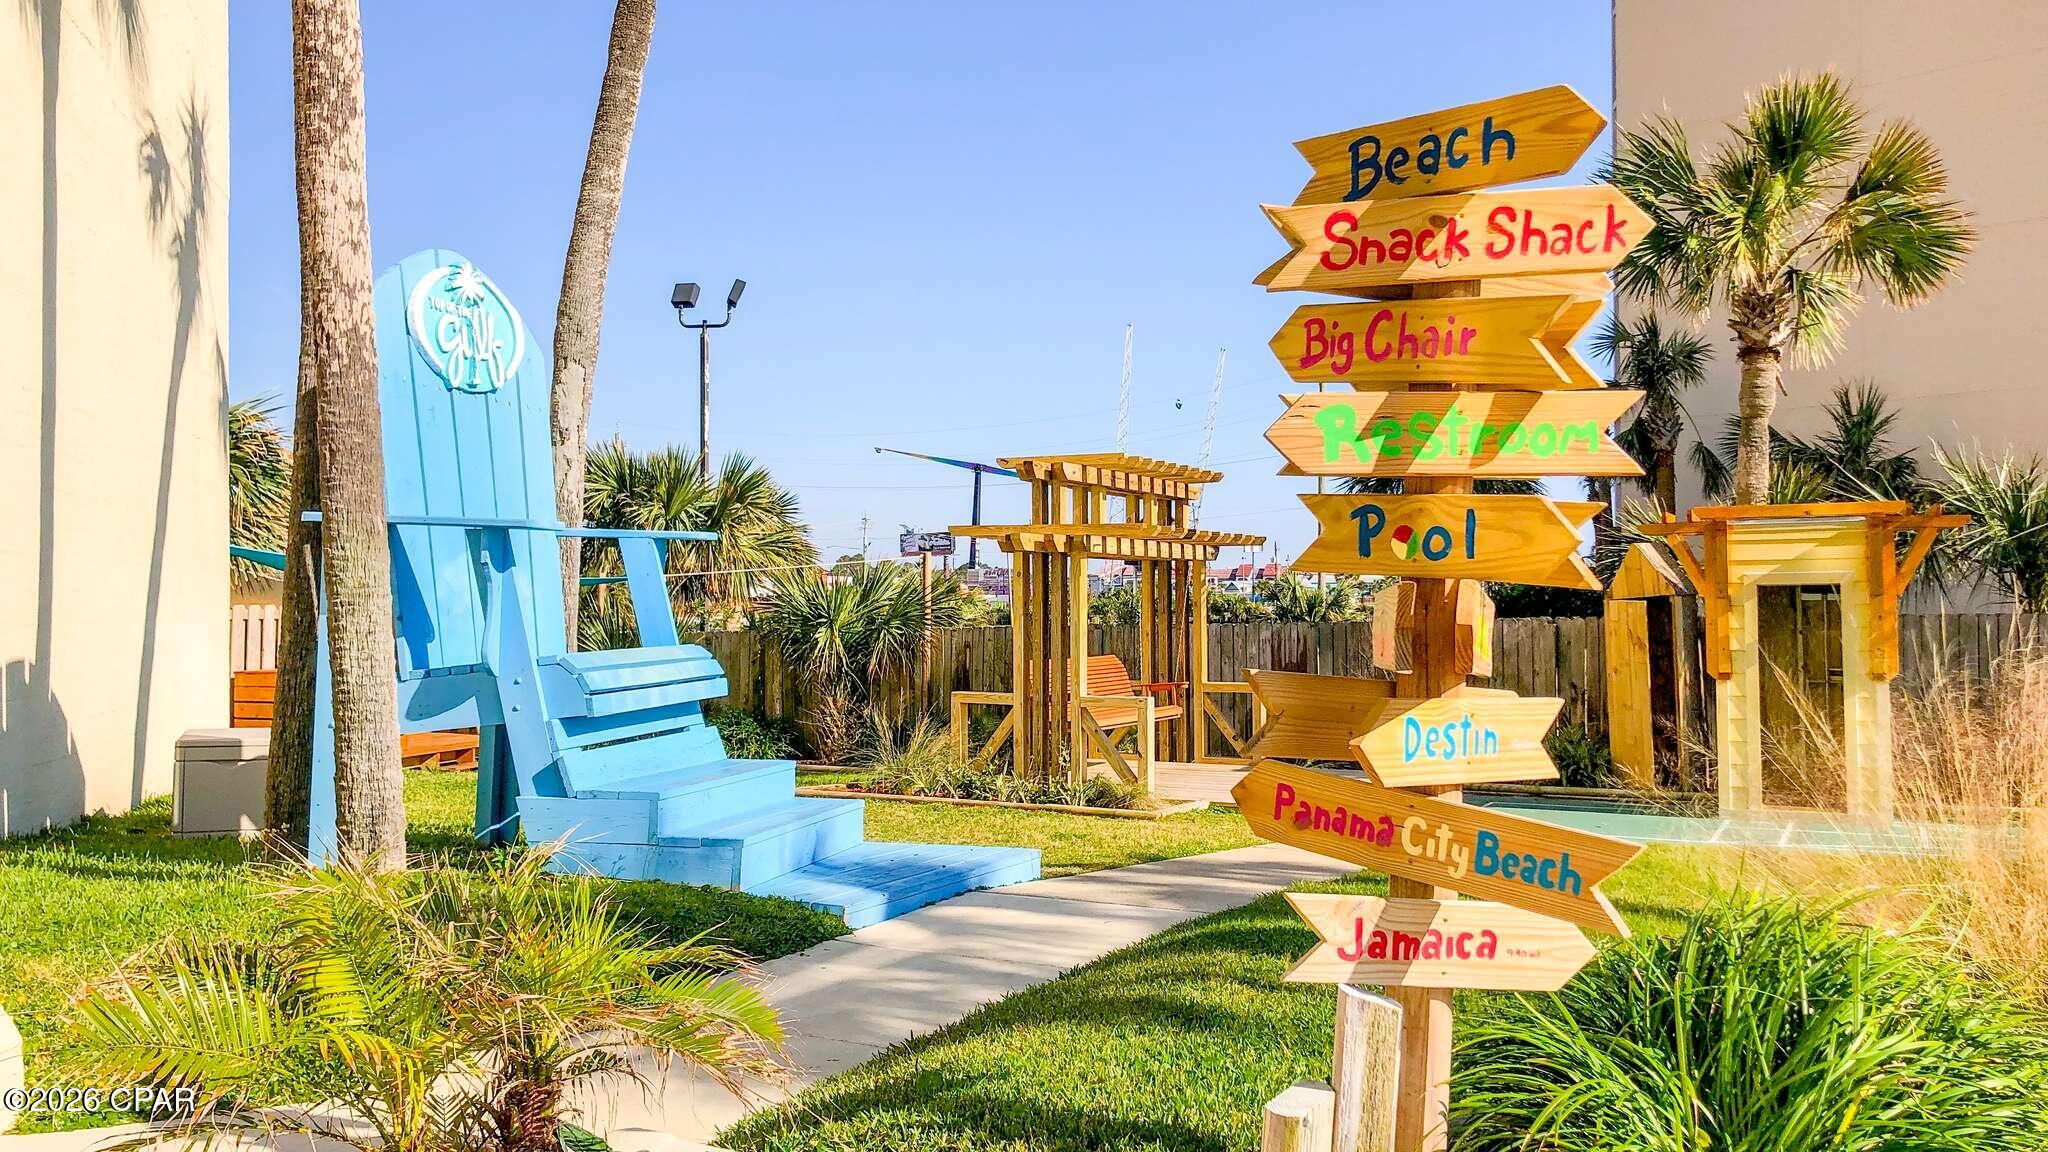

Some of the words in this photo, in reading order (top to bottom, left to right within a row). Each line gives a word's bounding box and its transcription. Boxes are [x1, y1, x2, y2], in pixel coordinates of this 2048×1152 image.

[1342, 116, 1516, 202] Beach
[1320, 210, 1470, 271] Snack
[1485, 203, 1629, 260] Shack
[1299, 317, 1355, 375] Big
[1364, 309, 1477, 362] Chair
[1314, 402, 1600, 464] Restroom
[1350, 503, 1476, 562] Pool
[1403, 713, 1498, 763] Destin
[1274, 783, 1395, 847] Panama
[1400, 816, 1469, 879] City
[1474, 830, 1581, 896] Beach
[1336, 917, 1498, 962] Jamaica
